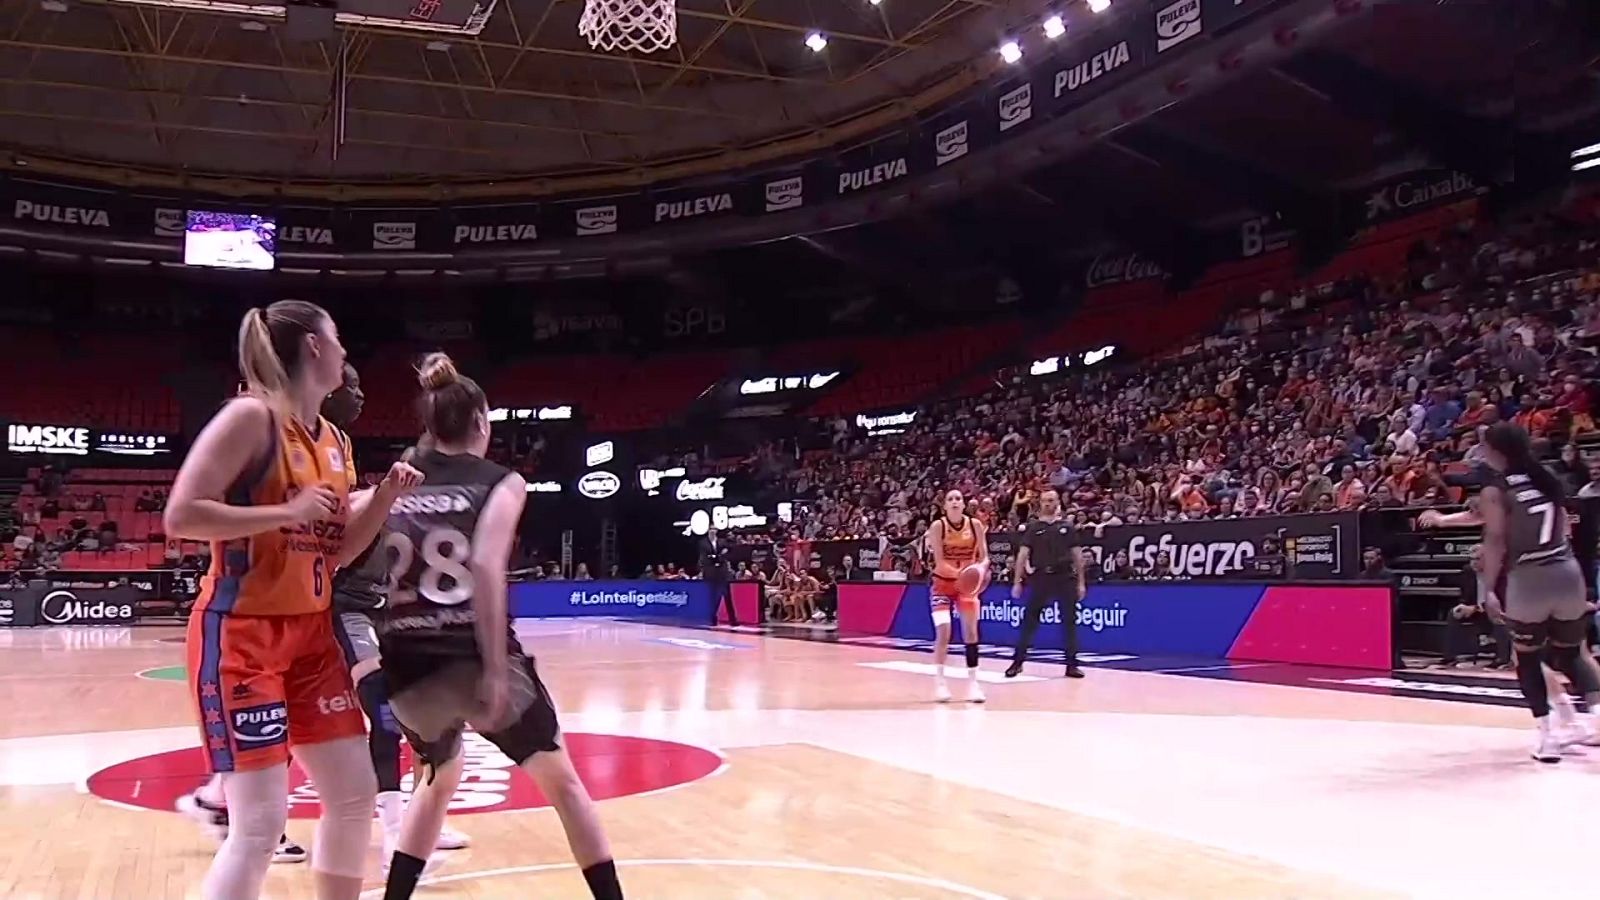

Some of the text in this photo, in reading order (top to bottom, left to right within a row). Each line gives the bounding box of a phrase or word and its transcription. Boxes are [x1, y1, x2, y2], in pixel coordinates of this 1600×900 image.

[1054, 41, 1130, 98] PULEVA
[839, 158, 908, 194] PULEVA
[15, 200, 110, 227] PULEVA
[655, 193, 733, 222] PULEVA
[280, 226, 333, 245] LEVA
[454, 224, 537, 243] PULEVA
[9, 425, 89, 447] IMSKE
[1527, 502, 1554, 545] 7
[313, 557, 323, 597] 6
[384, 529, 474, 606] 28
